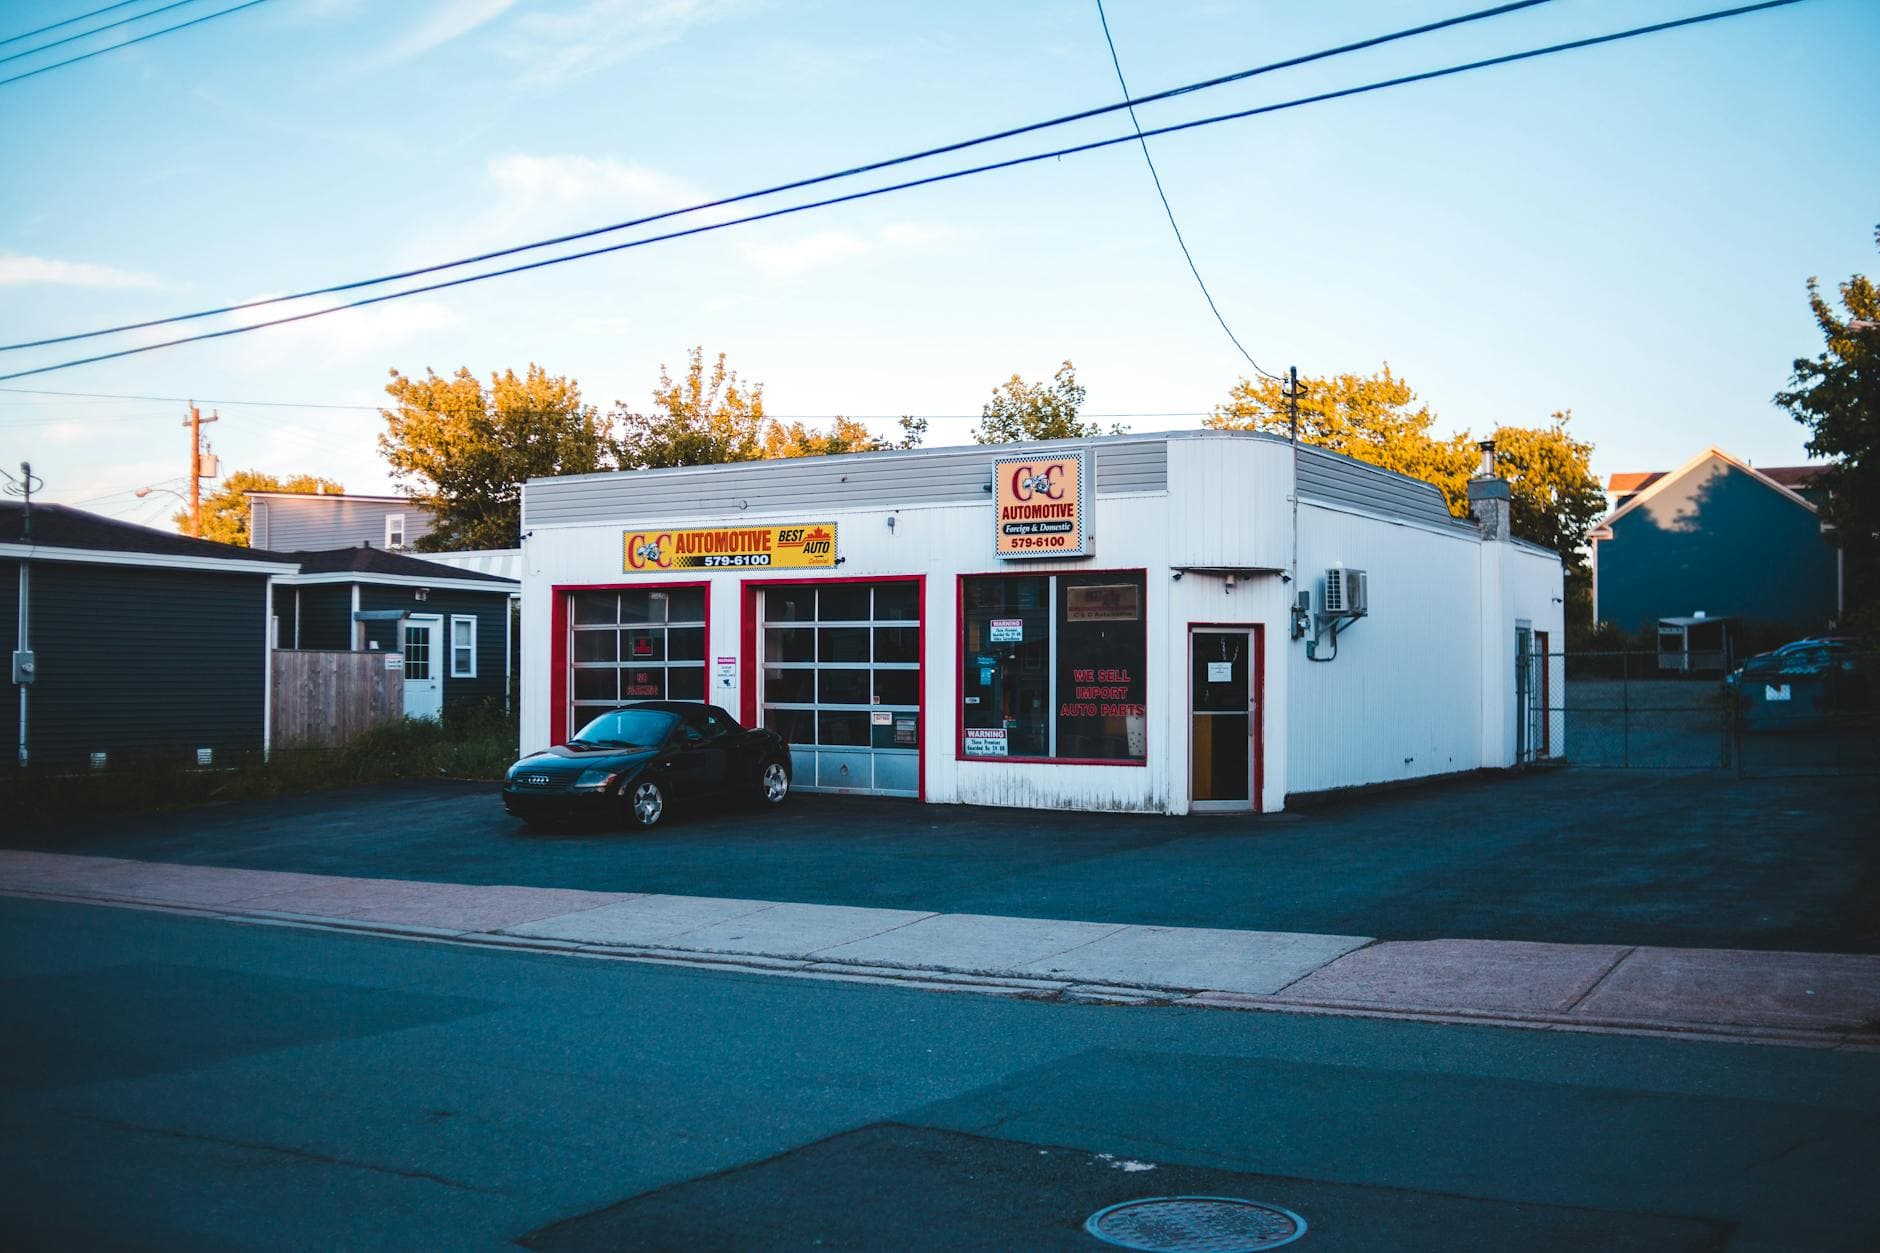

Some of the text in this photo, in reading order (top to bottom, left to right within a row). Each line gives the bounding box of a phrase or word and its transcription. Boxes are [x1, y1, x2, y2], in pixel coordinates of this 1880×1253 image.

[1002, 503, 1074, 520] AUTOMOTIVE
[1005, 522, 1071, 534] Foreign & Domestic
[675, 530, 772, 553] AUTOMOTIVE
[778, 529, 804, 542] BEST
[1011, 536, 1065, 548] 579-6100
[803, 541, 830, 554] AUTO
[703, 555, 770, 567] 579-6100
[1073, 669, 1131, 683] WE SELL
[1076, 687, 1128, 700] IMPORT
[1060, 703, 1145, 717] AUTO PARTS
[967, 730, 1004, 738] WARNING
